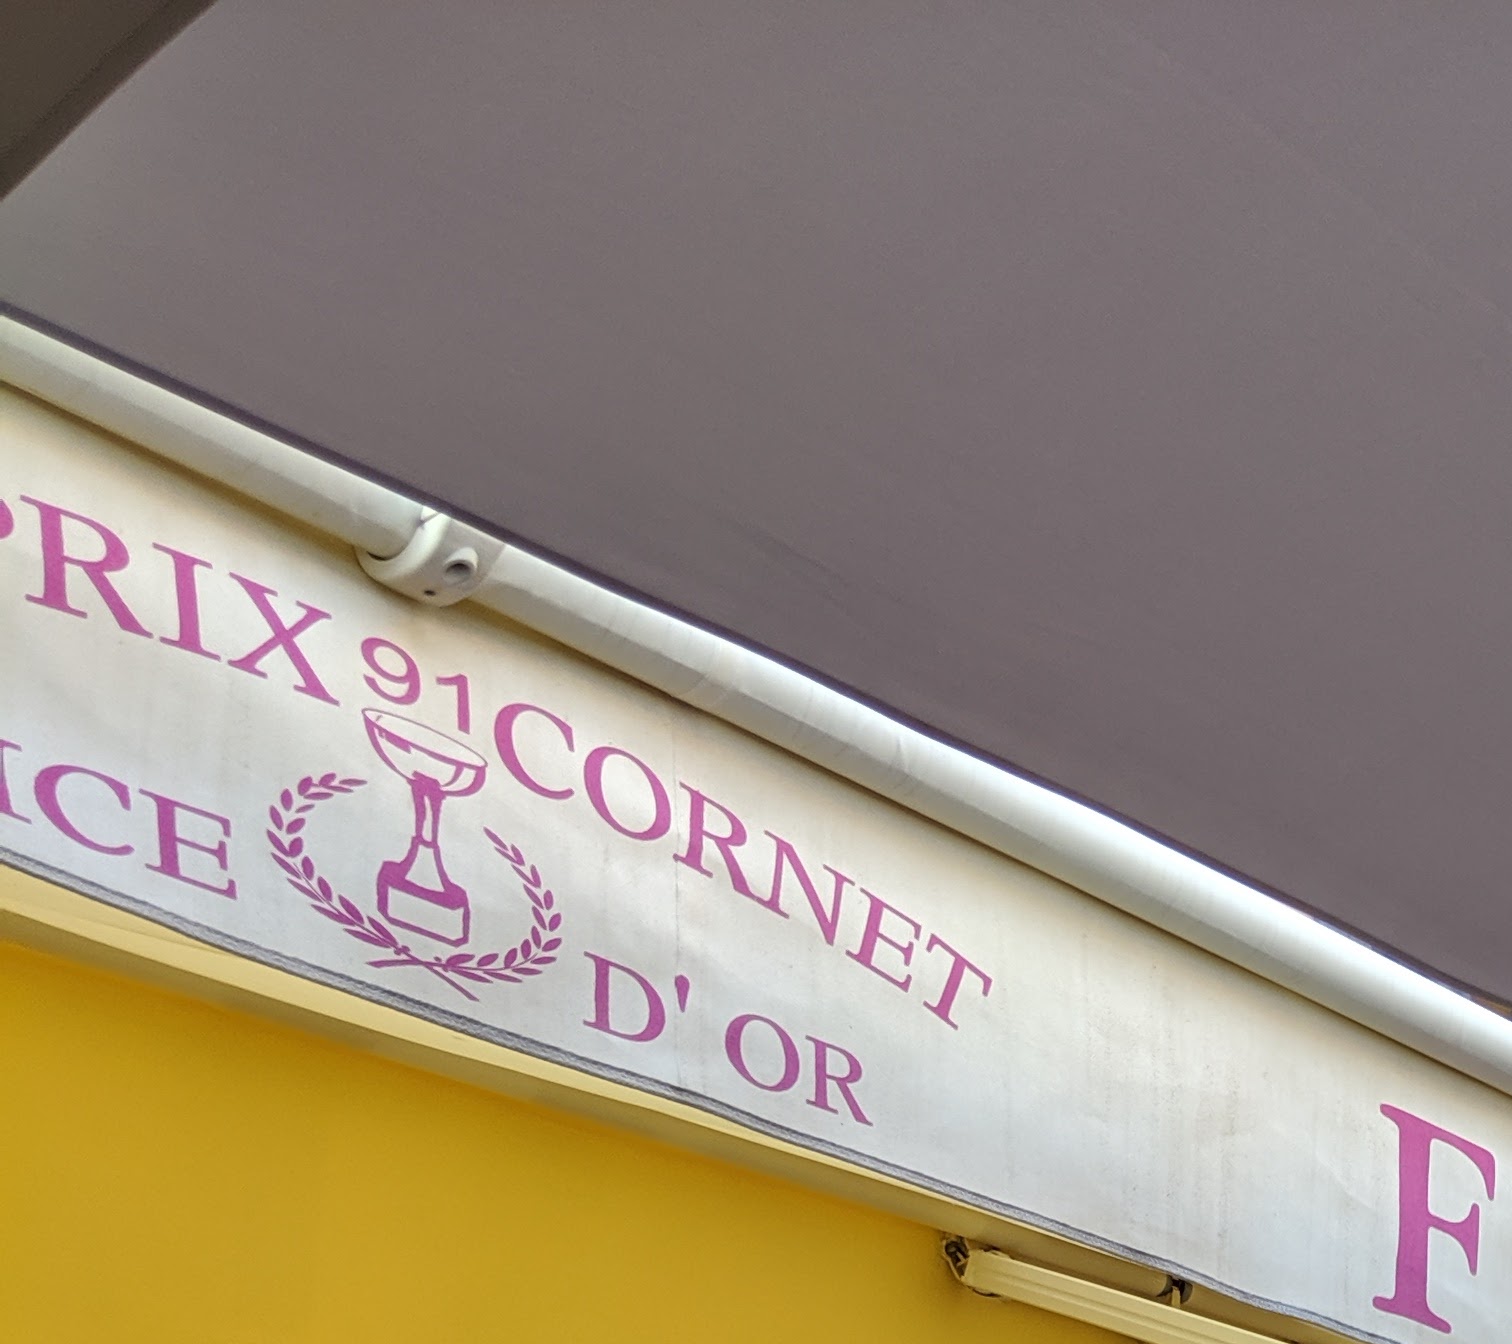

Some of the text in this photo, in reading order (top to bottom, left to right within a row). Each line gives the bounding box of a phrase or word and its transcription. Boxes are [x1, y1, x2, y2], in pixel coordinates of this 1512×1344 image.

[0, 494, 340, 707] RIX
[359, 637, 474, 734] 91
[492, 701, 992, 1030] CORNET
[725, 1013, 873, 1127] OR
